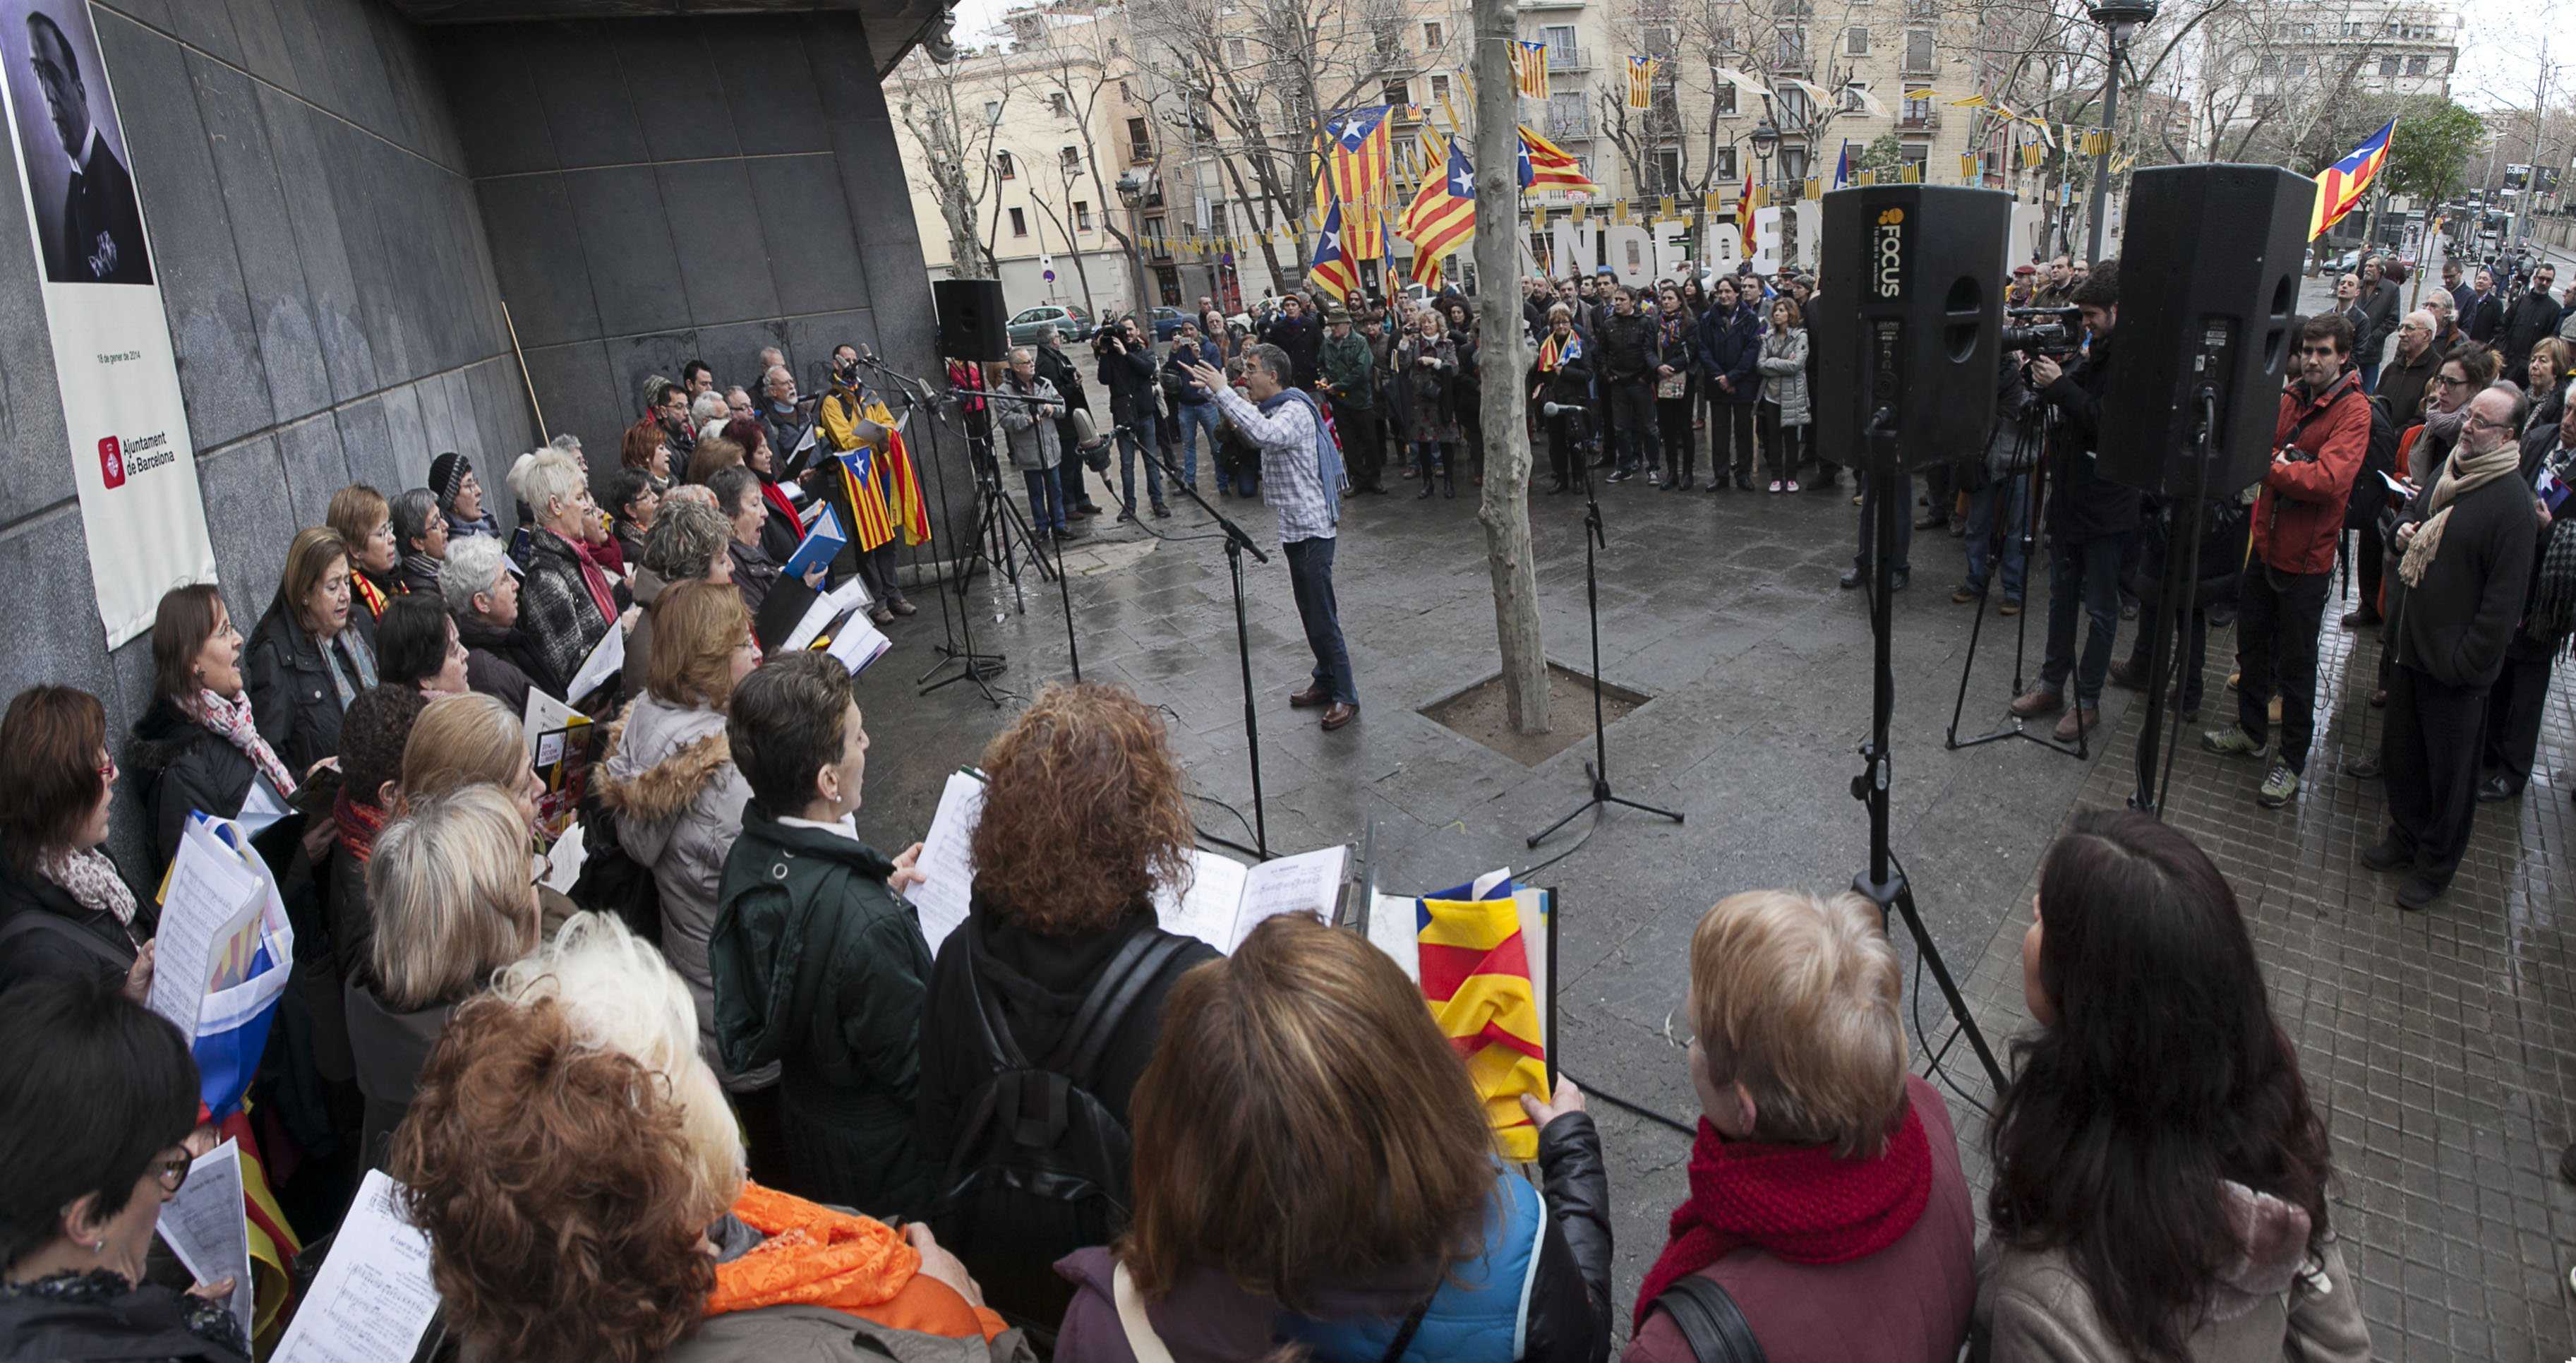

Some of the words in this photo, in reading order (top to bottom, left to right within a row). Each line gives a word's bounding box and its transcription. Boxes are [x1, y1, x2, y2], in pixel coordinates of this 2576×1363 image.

[1881, 225, 1901, 297] FOCUS
[123, 430, 167, 459] Ajuntament
[126, 460, 137, 476] de
[136, 450, 175, 473] Barcelona
